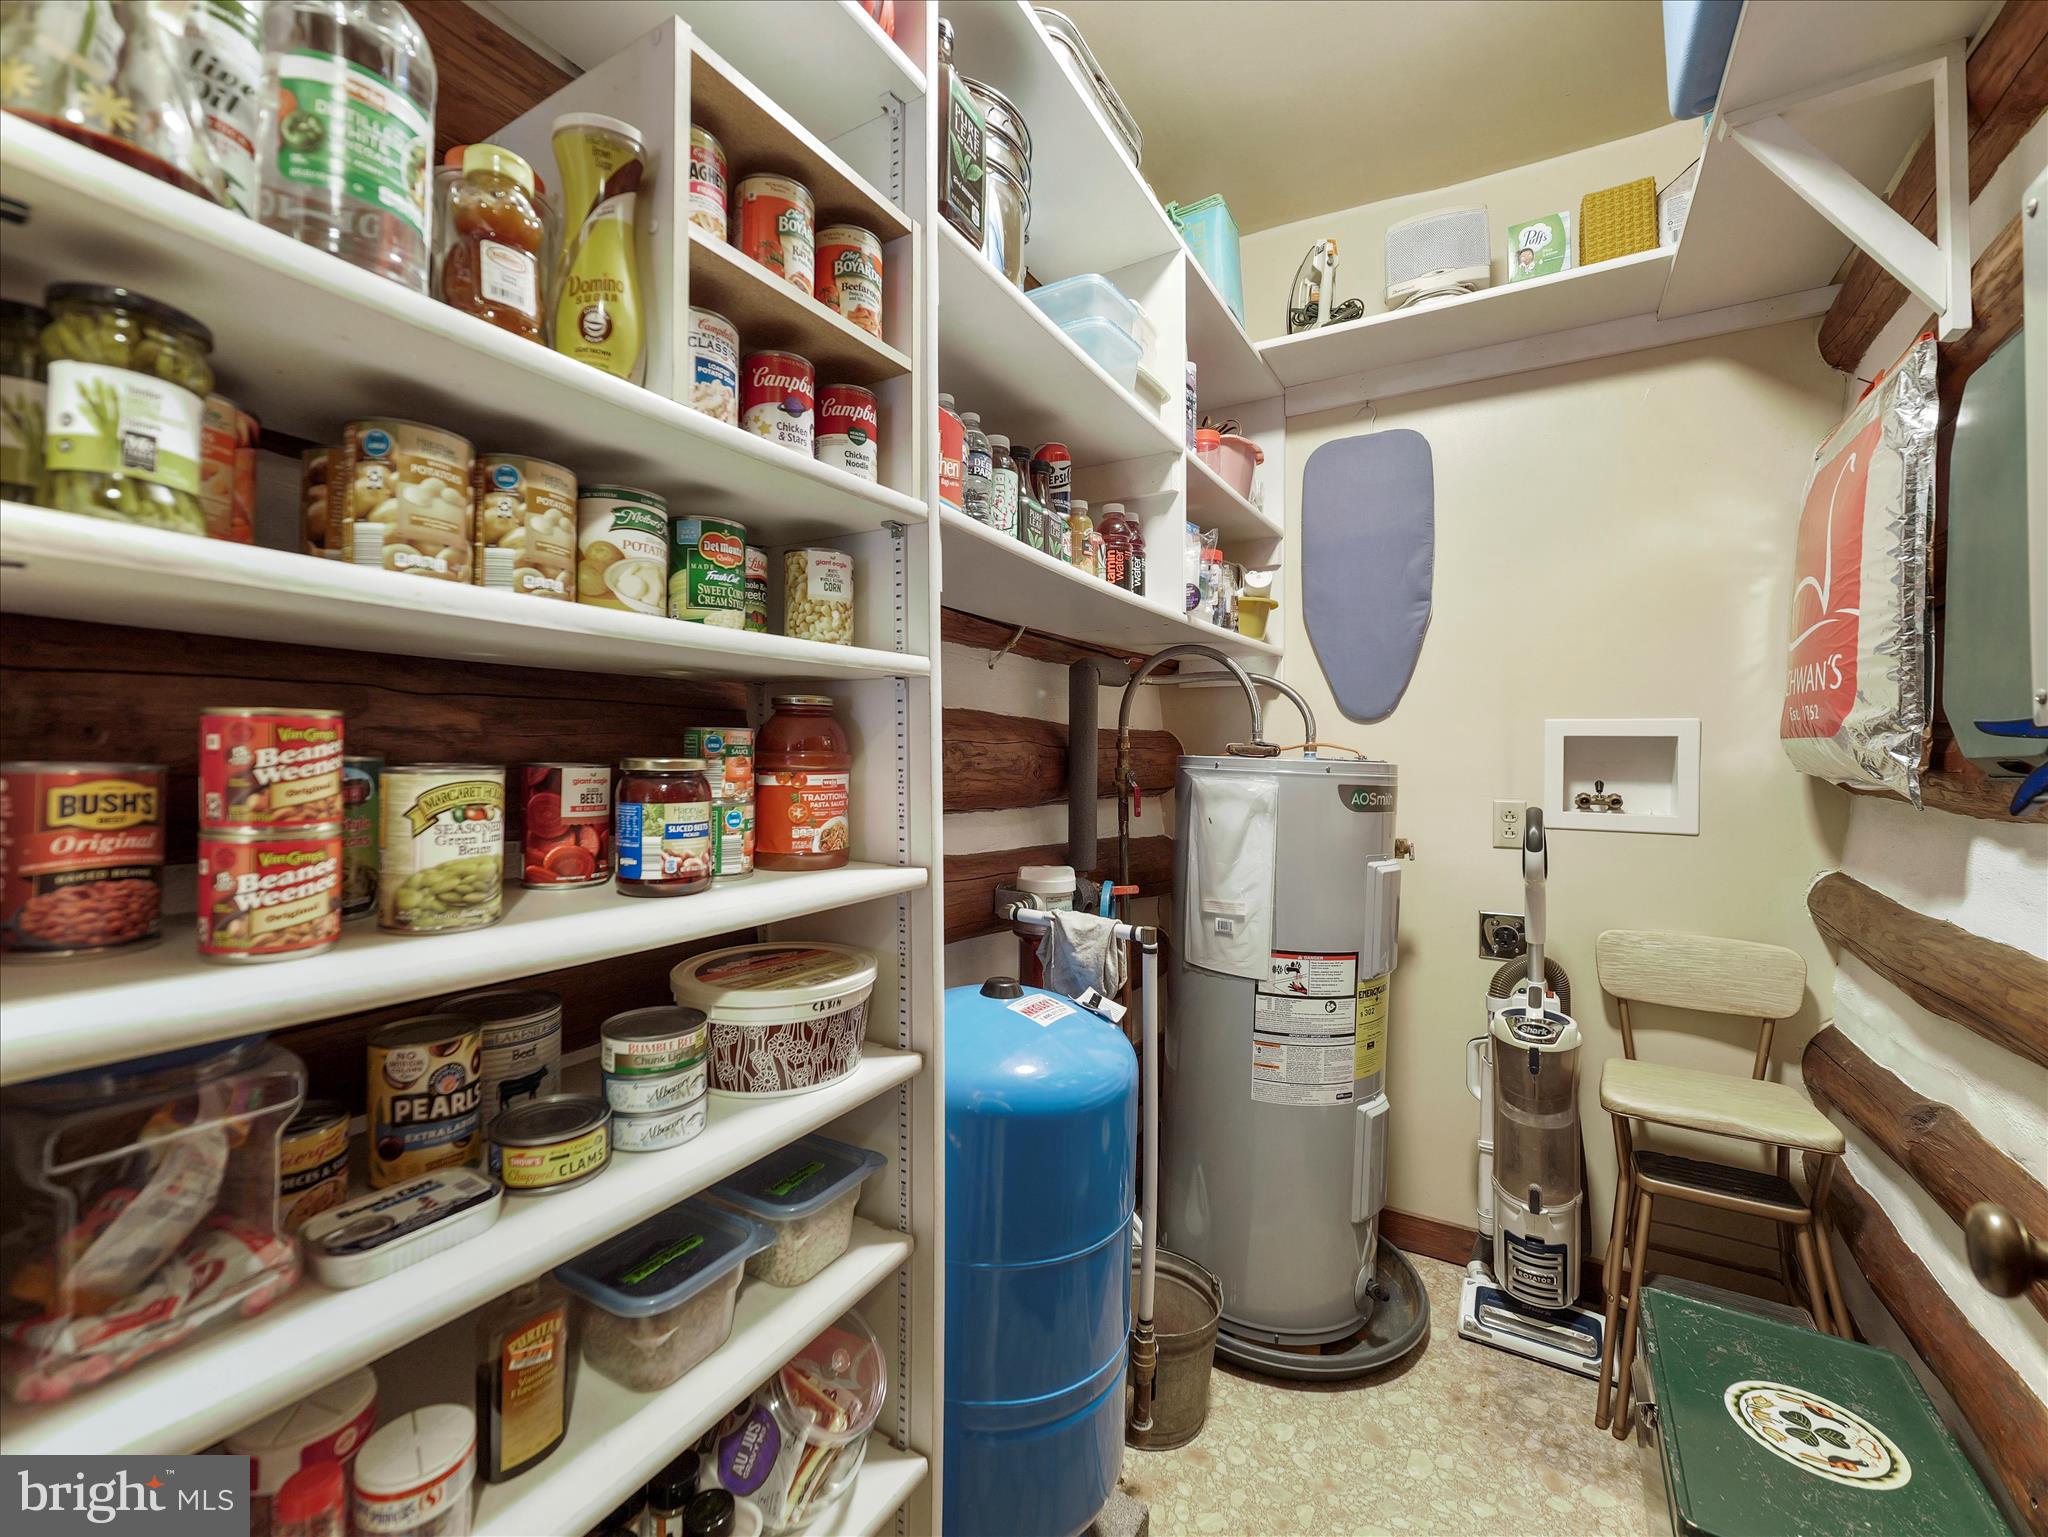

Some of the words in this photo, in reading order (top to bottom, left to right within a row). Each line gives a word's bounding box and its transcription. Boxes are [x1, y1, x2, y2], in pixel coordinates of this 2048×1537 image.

[955, 102, 979, 143] PURE
[955, 117, 979, 153] LEAF
[1523, 229, 1548, 247] Puffs
[568, 274, 624, 297] Domino
[776, 421, 808, 436] Chicken
[778, 431, 785, 441] &
[787, 432, 807, 446] Stars
[844, 450, 870, 462] Chicken
[846, 459, 869, 470] Noodle
[703, 540, 719, 552] Del
[815, 559, 831, 567] giant
[1116, 550, 1124, 580] water
[1133, 556, 1142, 587] water
[697, 583, 726, 597] SWEET
[823, 582, 842, 593] CORN
[697, 593, 727, 606] CREAM
[423, 785, 483, 810] MARGARET
[580, 792, 603, 805] BEETS
[58, 792, 153, 820] BUSH'S
[668, 823, 693, 833] SLICED
[50, 830, 155, 856] Original
[434, 834, 477, 848] Green
[458, 844, 492, 856] Beans
[812, 999, 842, 1013] CABIN
[1520, 1024, 1548, 1036] Shark
[628, 1041, 673, 1054] BUMBLE
[632, 1054, 665, 1065] Chunk
[394, 1083, 480, 1122] PEARLS
[404, 1129, 445, 1143] EXTRA
[559, 1147, 604, 1176] CLAMS
[1518, 1270, 1554, 1285] ROTATOR
[732, 1451, 748, 1477] AU
[742, 1420, 761, 1451] JUS
